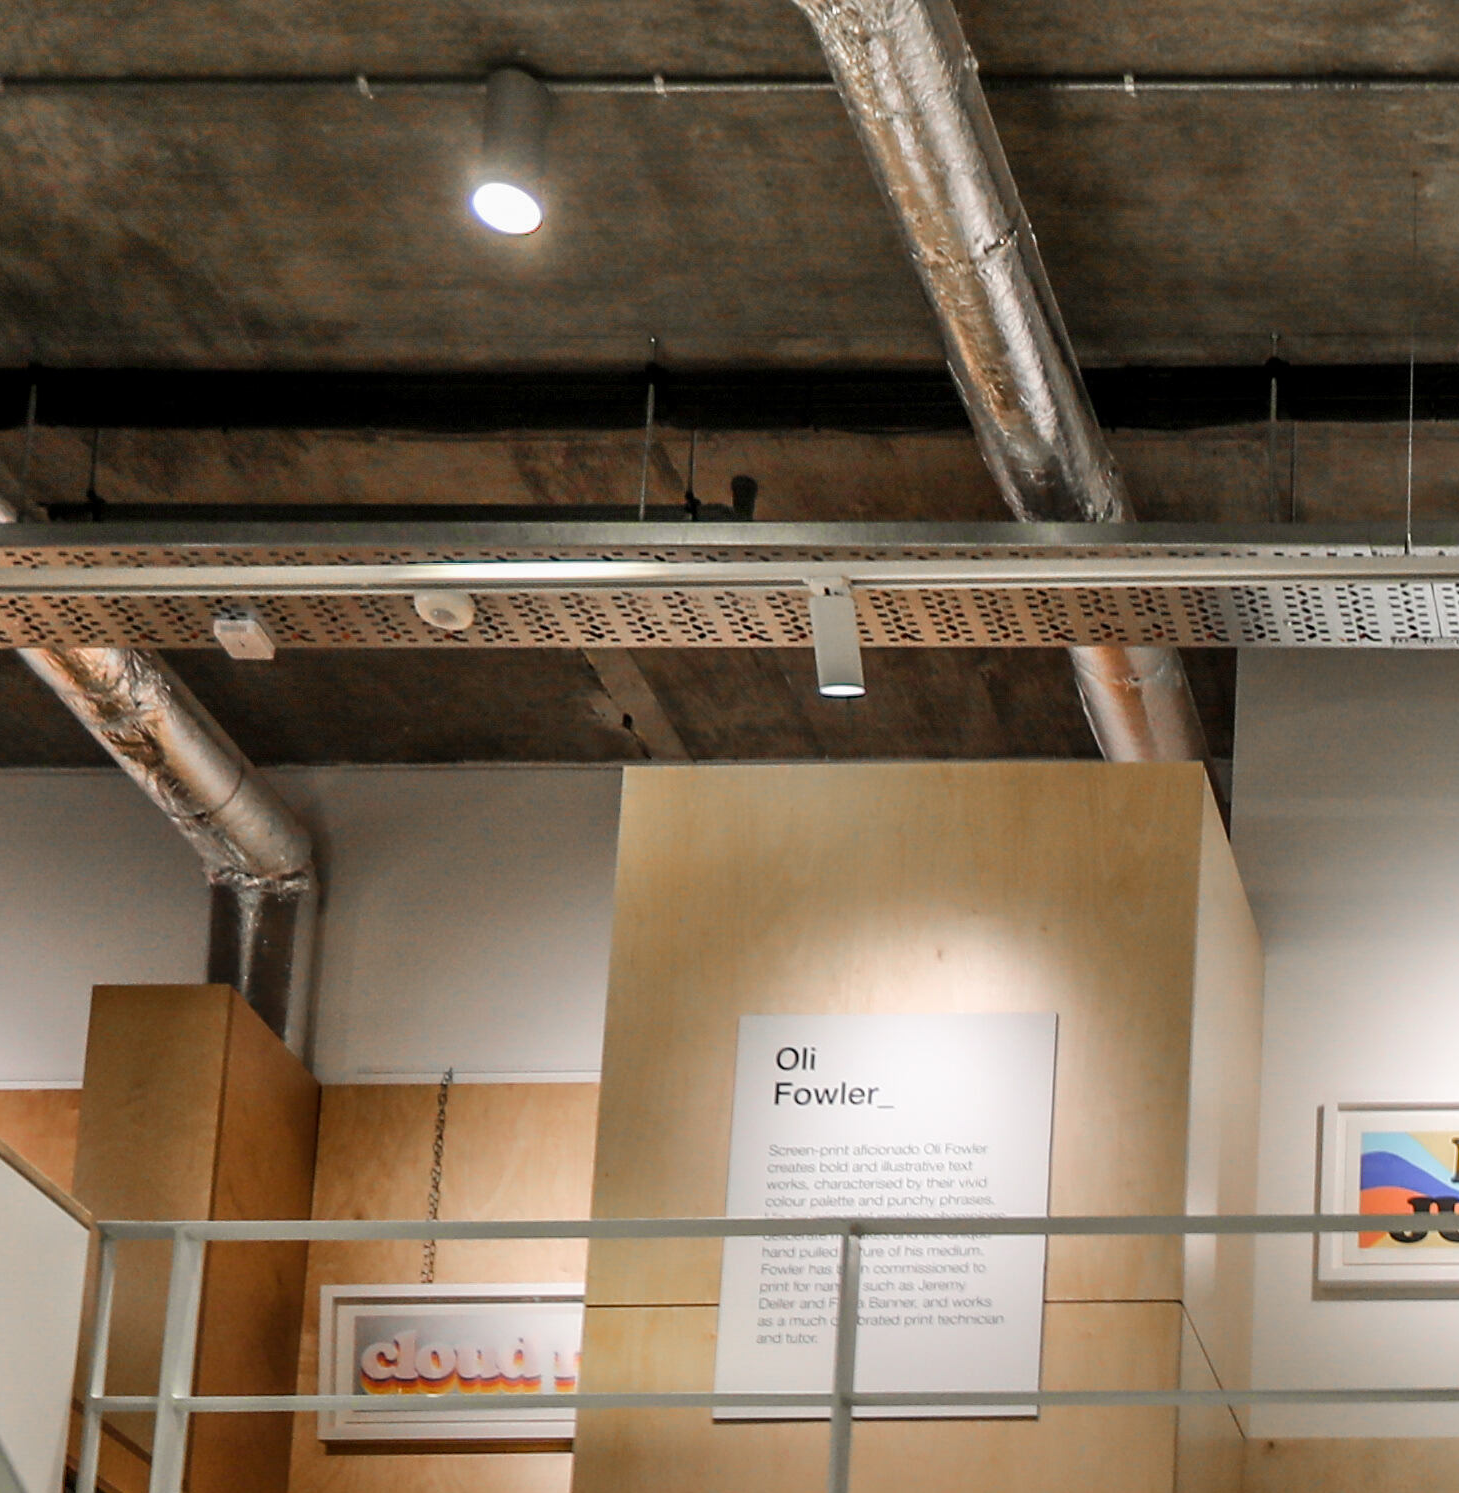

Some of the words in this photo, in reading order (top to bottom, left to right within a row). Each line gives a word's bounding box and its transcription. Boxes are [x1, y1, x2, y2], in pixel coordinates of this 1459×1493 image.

[775, 1046, 816, 1071] Oli
[767, 1143, 850, 1159] Screen-print
[851, 1143, 919, 1156] aficionado
[922, 1142, 941, 1155] Oli
[943, 1142, 988, 1155] Fowler
[766, 1160, 815, 1173] creates
[818, 1160, 849, 1173] bold
[851, 1160, 878, 1172] and
[880, 1159, 945, 1172] illustrative
[946, 1159, 973, 1172] text
[813, 1177, 902, 1190] characterised
[905, 1176, 921, 1192] by
[925, 1176, 955, 1189] their
[957, 1176, 987, 1189] vivid
[764, 1195, 806, 1207] colour
[808, 1194, 855, 1210] palette
[857, 1194, 883, 1206] and
[886, 1193, 934, 1209] punchy
[755, 1332, 782, 1344] and
